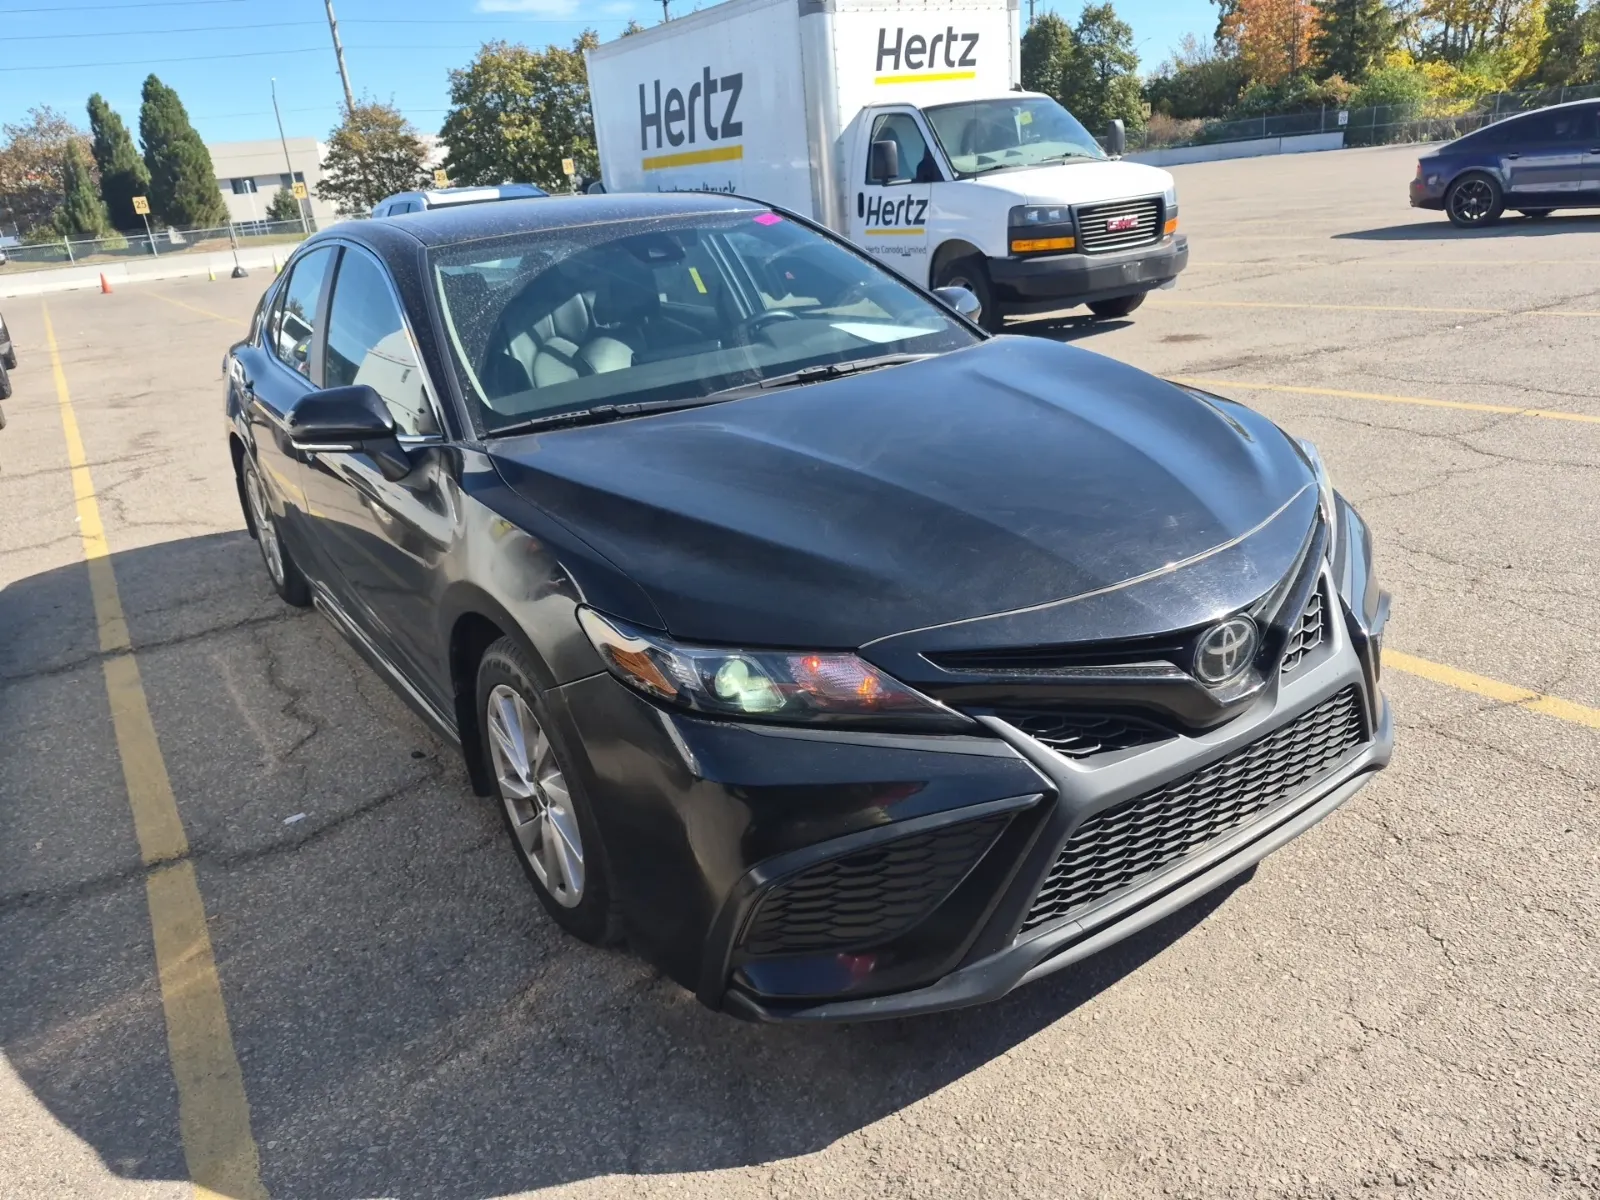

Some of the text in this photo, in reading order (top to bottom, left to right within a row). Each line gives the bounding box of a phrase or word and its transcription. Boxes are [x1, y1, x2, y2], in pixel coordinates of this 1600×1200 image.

[876, 26, 979, 71] Hertz
[639, 66, 743, 151] Hertz
[294, 185, 304, 194] 27
[135, 200, 147, 209] 25
[866, 194, 929, 226] Hertz
[1106, 215, 1138, 231] GMC
[881, 245, 903, 254] Canada
[904, 245, 926, 254] Limited
